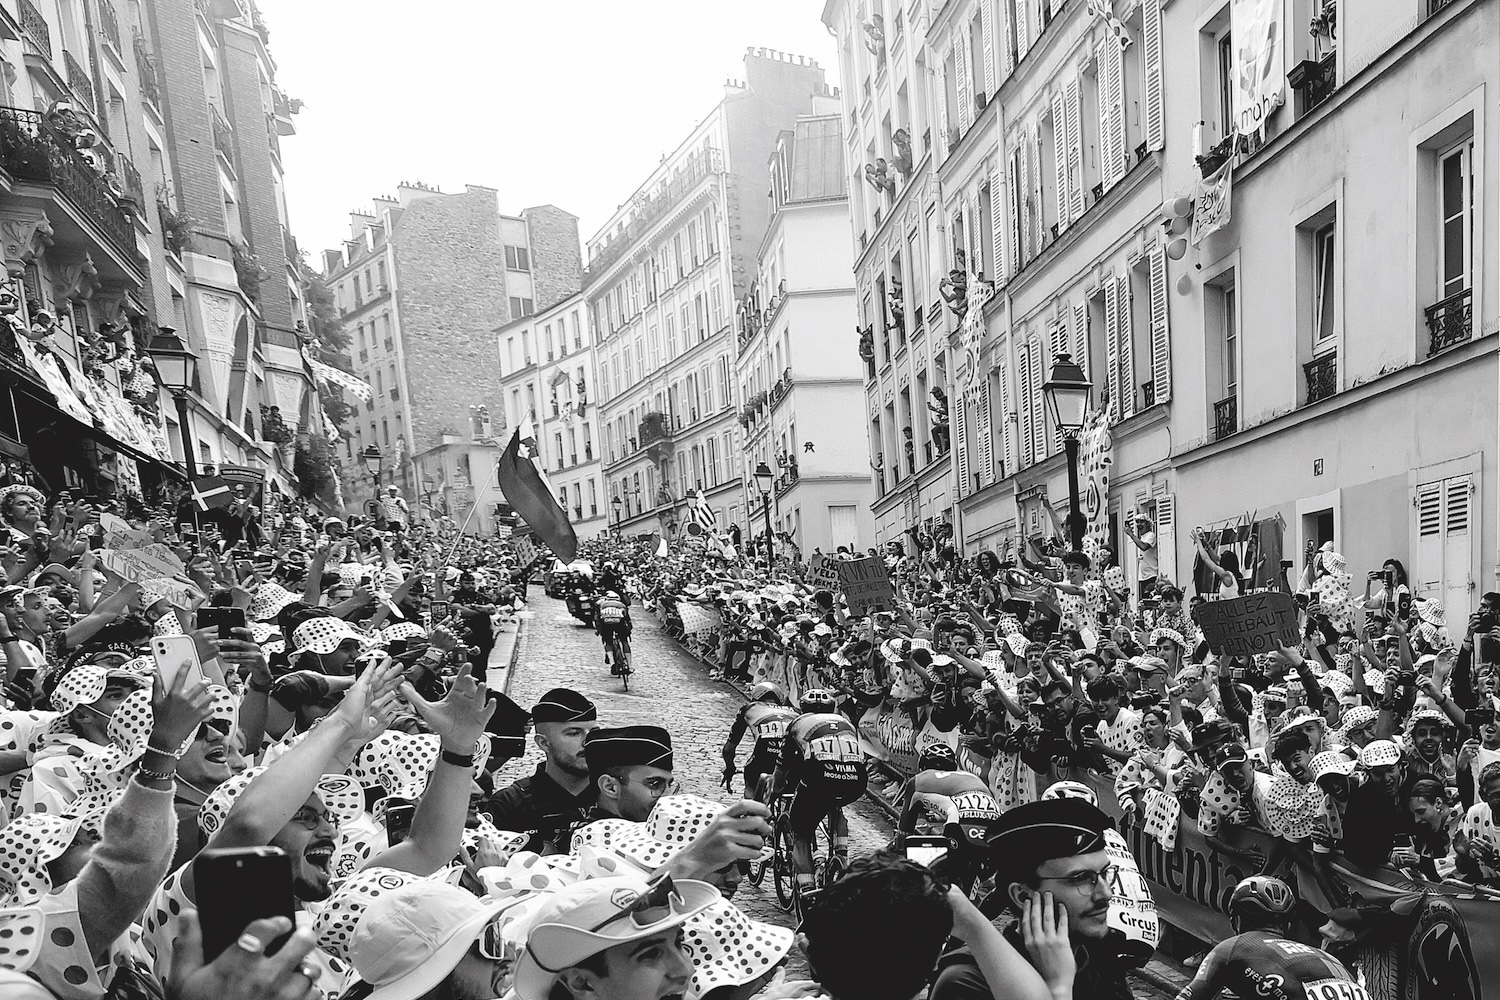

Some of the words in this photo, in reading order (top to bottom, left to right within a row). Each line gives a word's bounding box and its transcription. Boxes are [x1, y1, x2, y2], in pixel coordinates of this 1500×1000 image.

[1218, 597, 1268, 619] ALLEZ
[1218, 610, 1287, 635] THIBAUT
[1226, 631, 1276, 652] PINOT
[765, 723, 778, 733] 14
[820, 739, 833, 753] 17
[835, 763, 857, 773] VISMA
[1119, 911, 1156, 930] Circus
[1244, 967, 1263, 982] eyes
